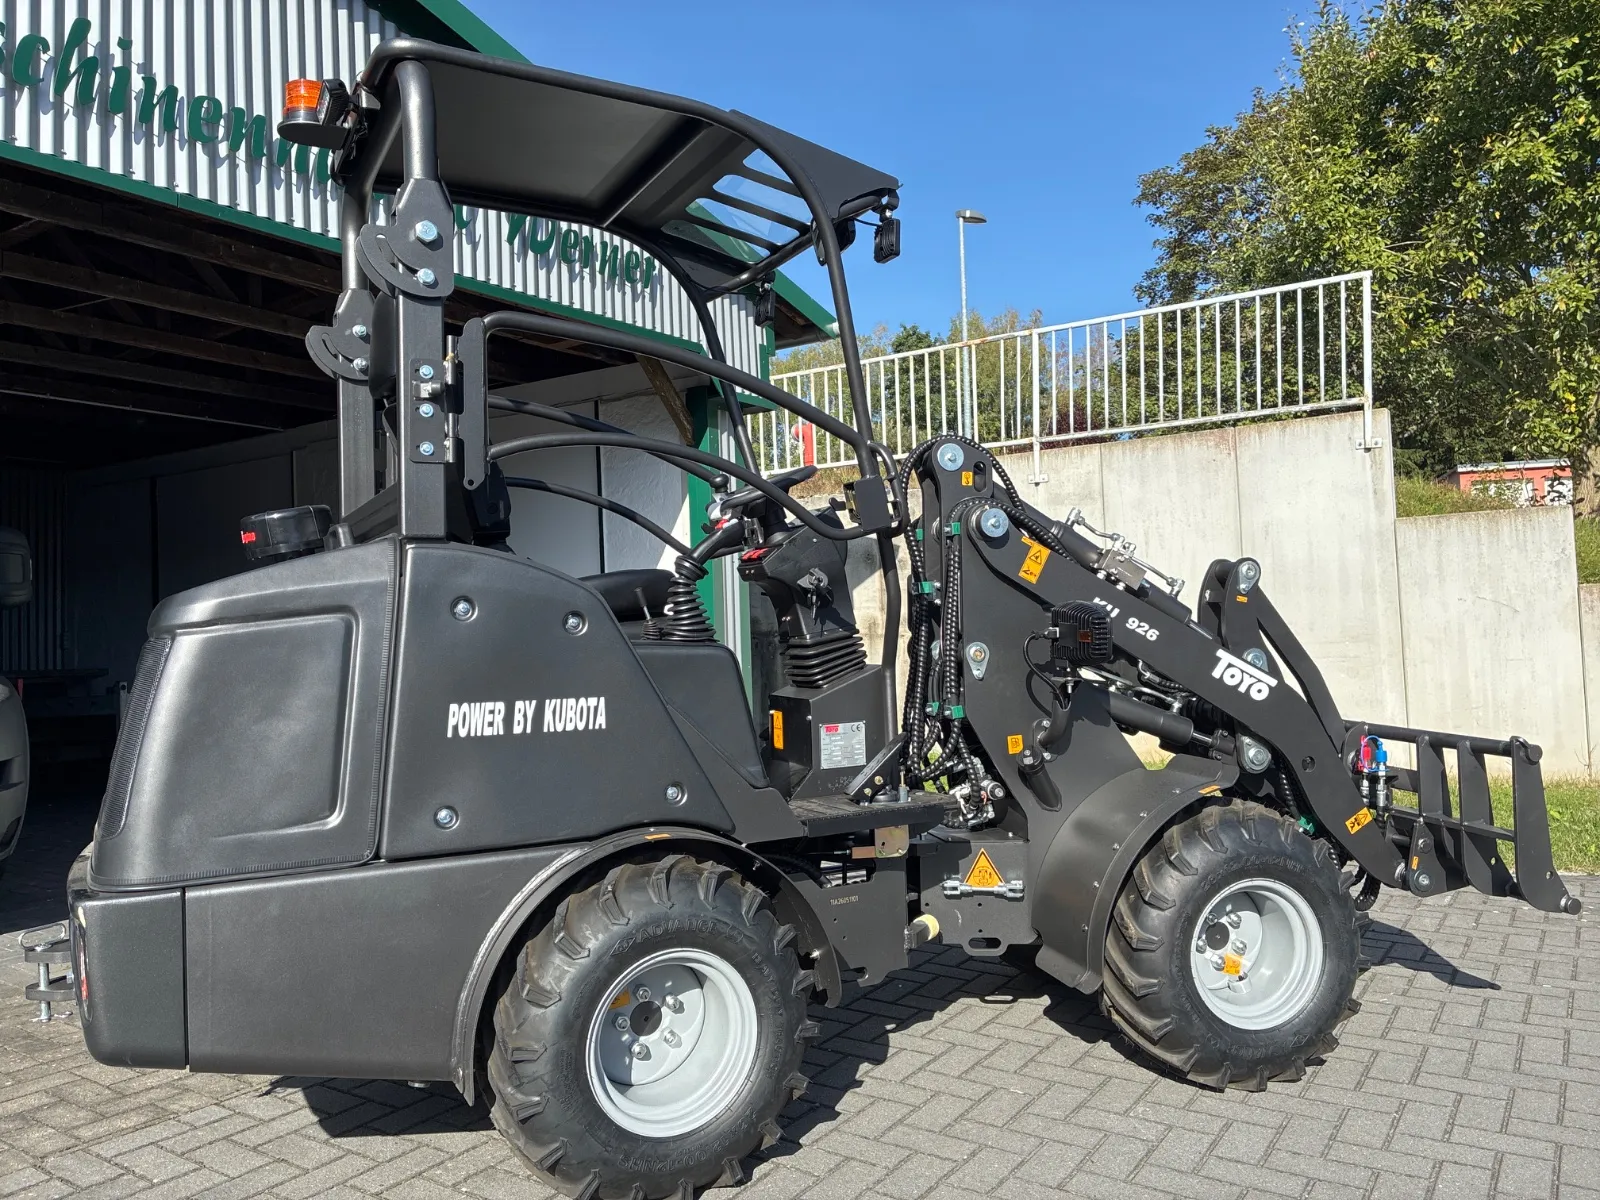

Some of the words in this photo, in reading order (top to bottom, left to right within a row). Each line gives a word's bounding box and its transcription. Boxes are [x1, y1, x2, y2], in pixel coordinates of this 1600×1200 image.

[1125, 617, 1160, 641] 926
[1211, 648, 1278, 701] TOYO
[447, 701, 505, 738] POWER
[513, 700, 537, 734] BY
[543, 696, 606, 732] KUBOTA
